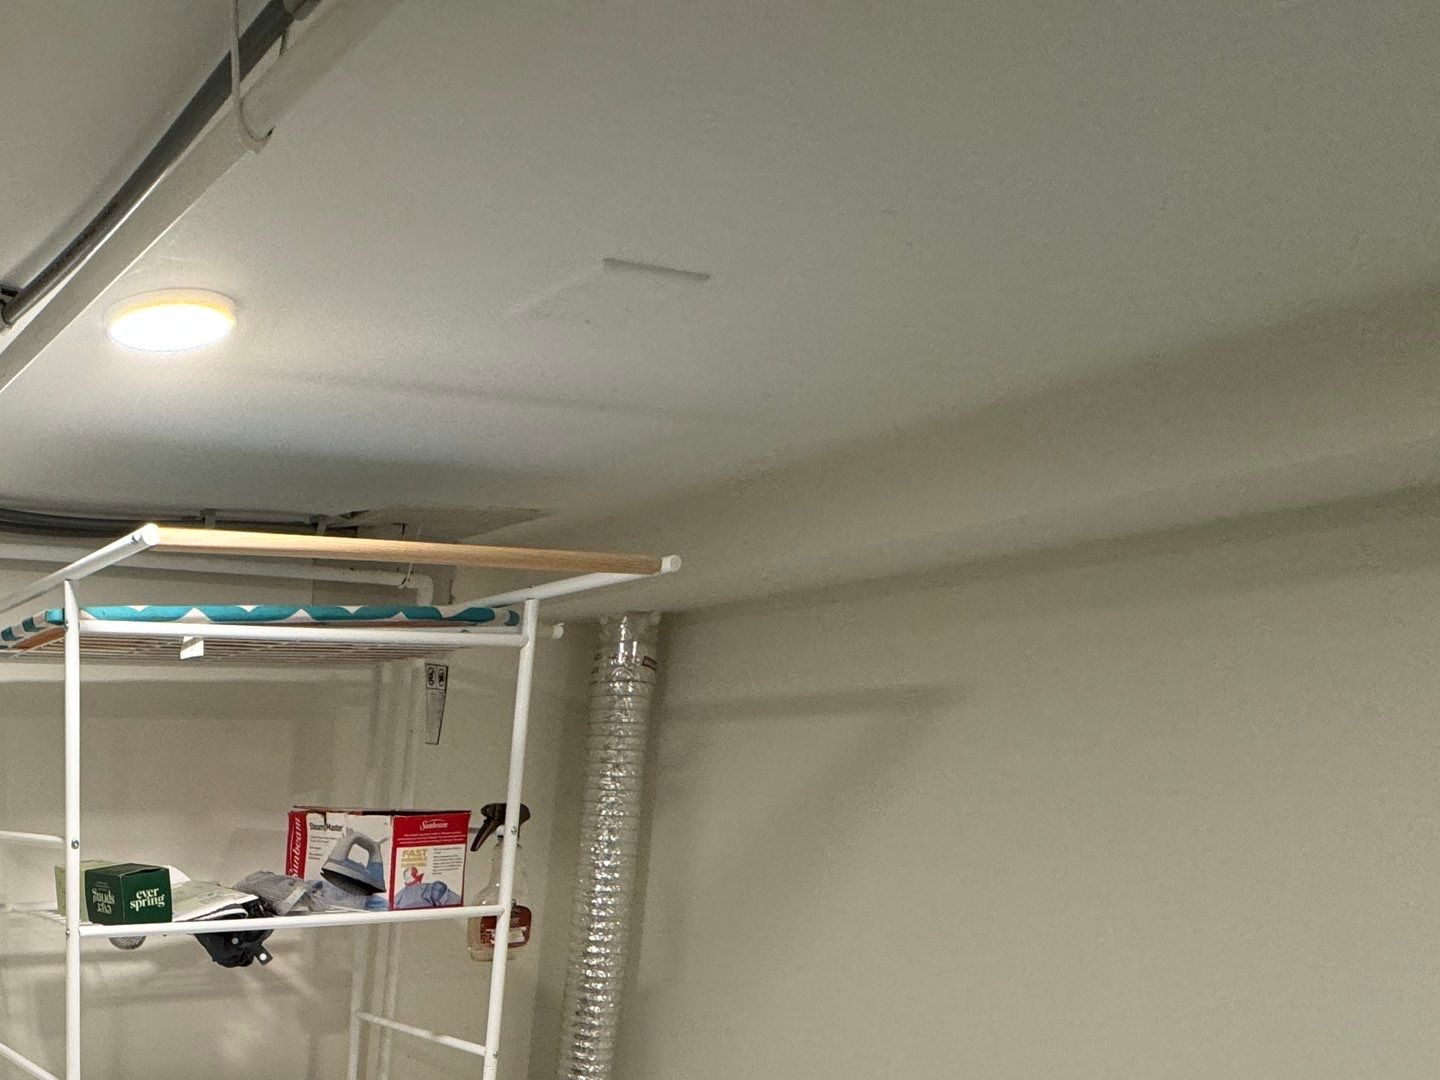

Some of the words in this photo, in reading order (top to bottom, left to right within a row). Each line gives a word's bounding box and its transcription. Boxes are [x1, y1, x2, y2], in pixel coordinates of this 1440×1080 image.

[326, 823, 344, 832] Master
[420, 820, 448, 831] Sunbeam
[289, 818, 301, 878] Sunbeam
[402, 849, 428, 858] FAST
[136, 888, 160, 899] ever
[129, 894, 165, 912] spring
